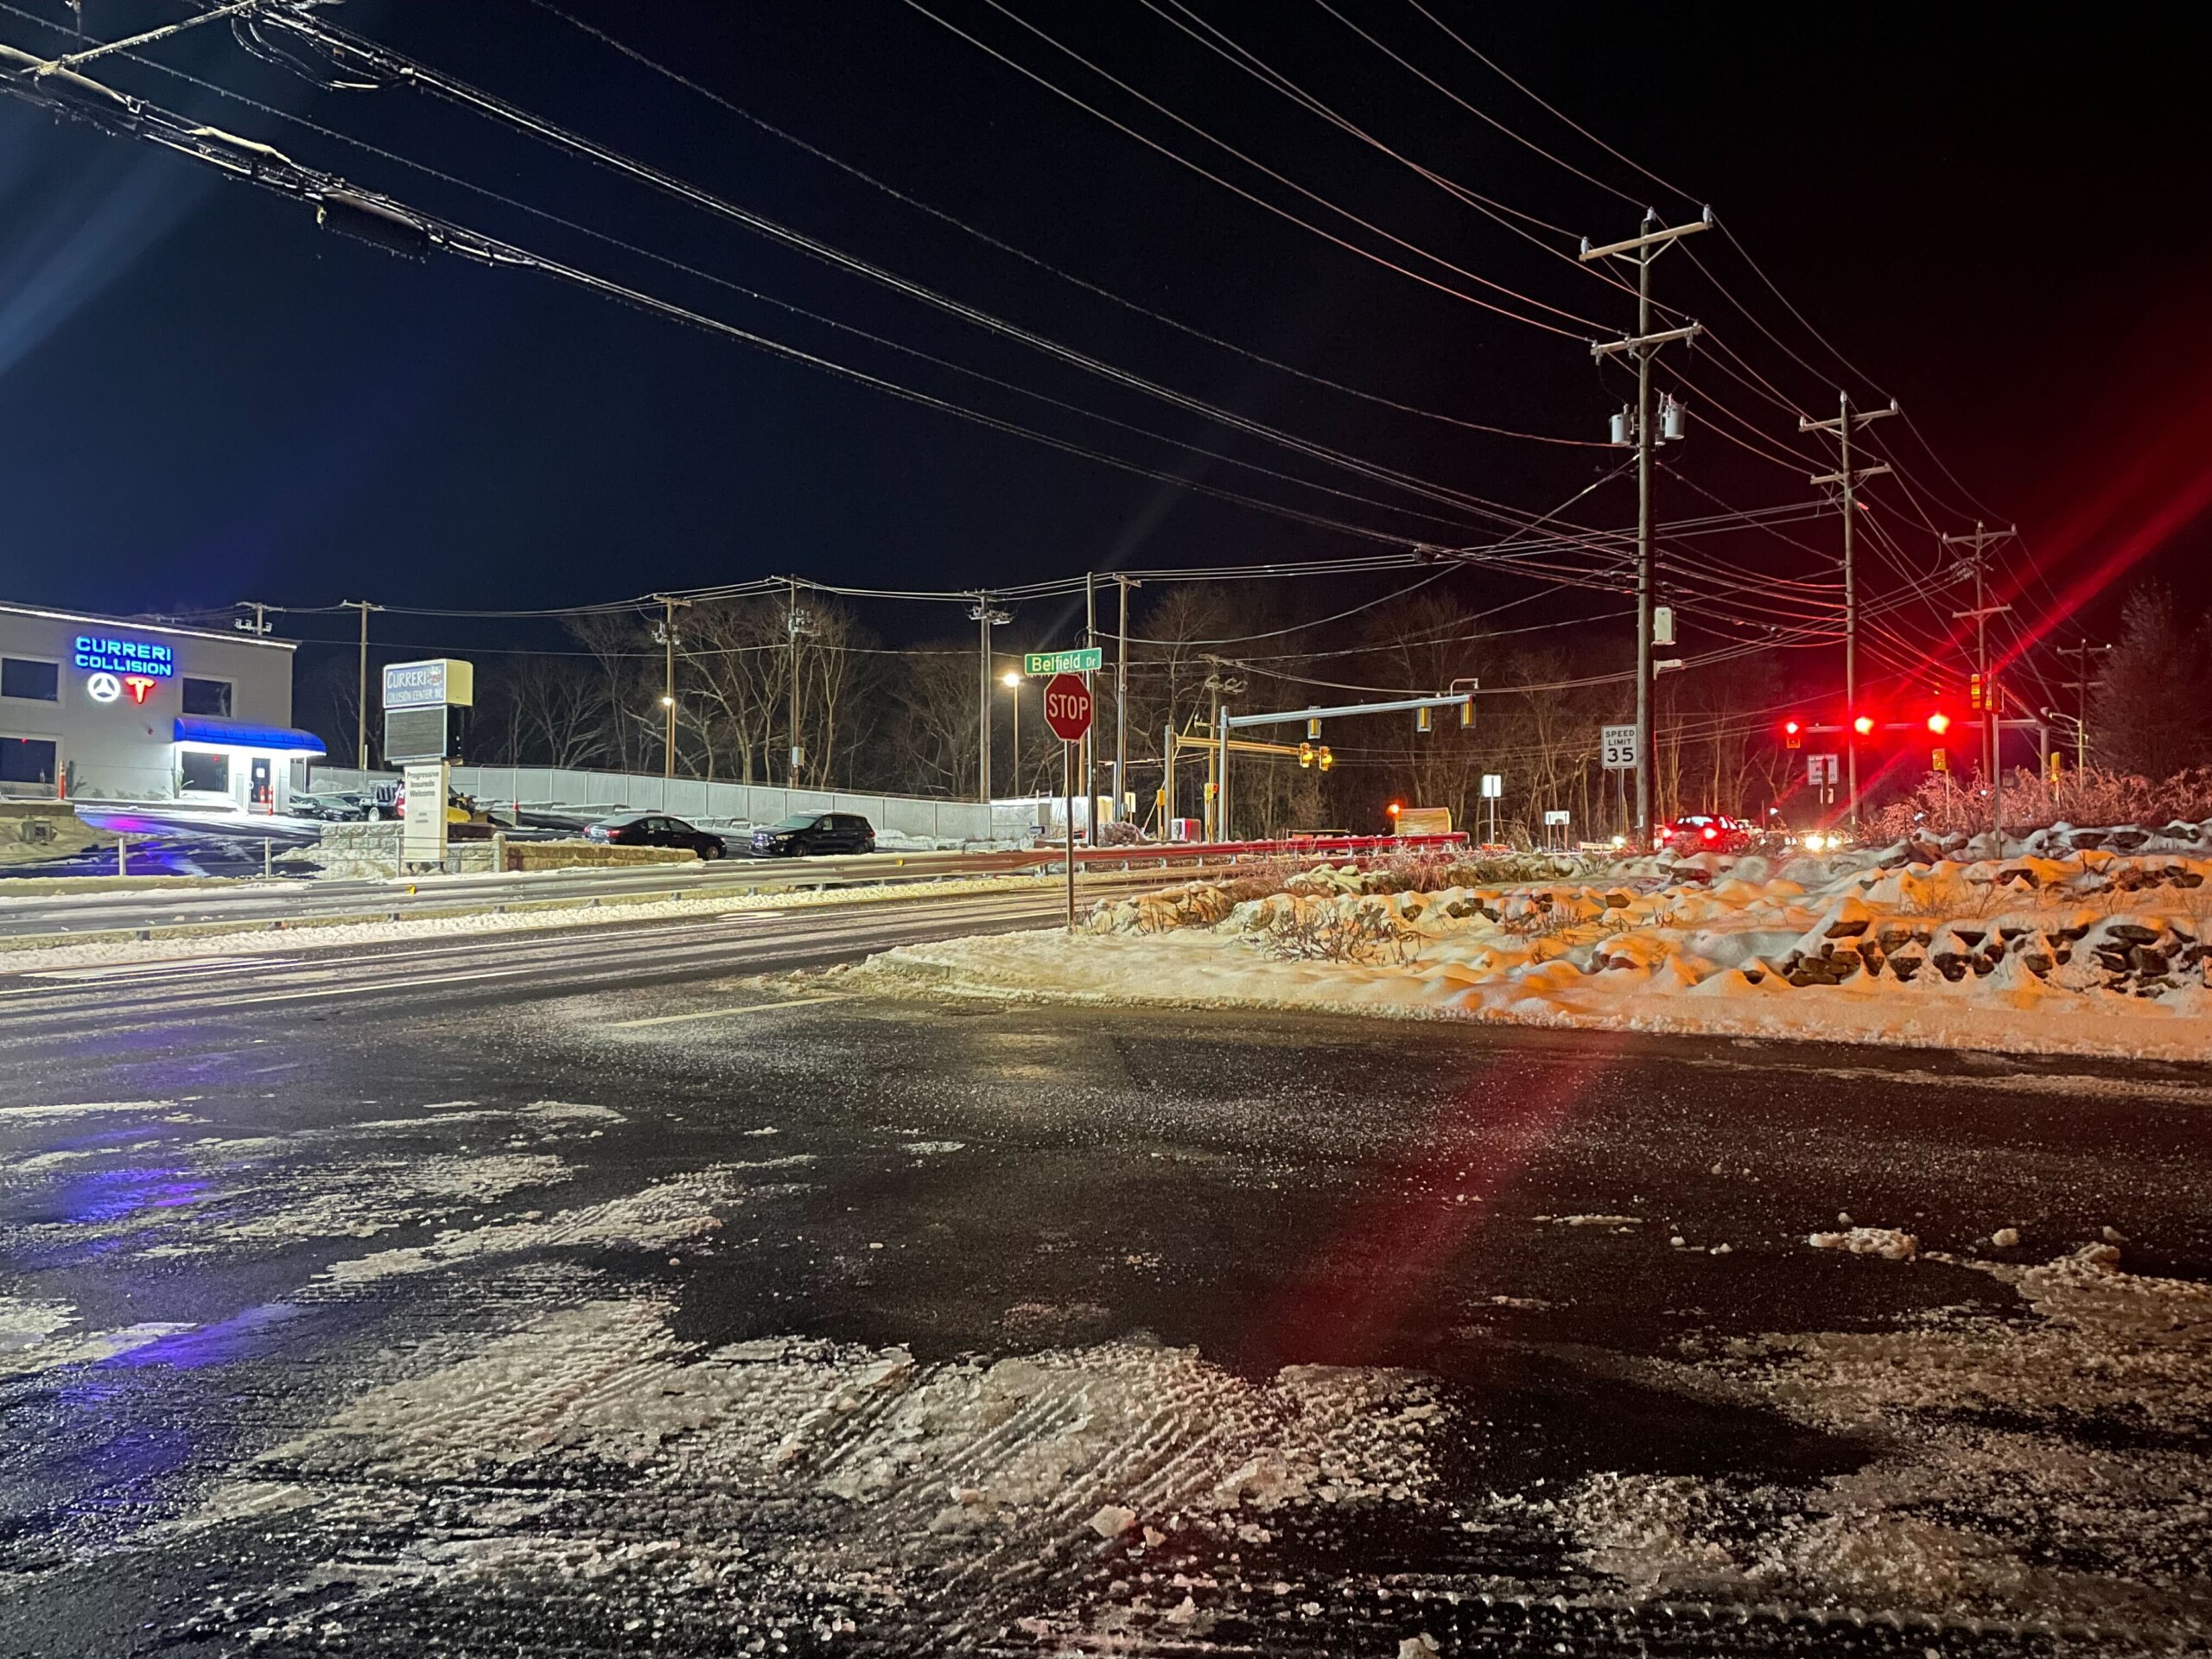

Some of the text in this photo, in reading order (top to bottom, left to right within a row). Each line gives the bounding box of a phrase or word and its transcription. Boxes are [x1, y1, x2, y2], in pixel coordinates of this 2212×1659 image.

[75, 636, 172, 661] CURRERI
[75, 653, 172, 676] COLLISION
[1032, 655, 1096, 672] Belfield Dr
[387, 671, 427, 689] CURRERI
[413, 689, 433, 701] CENTER
[1048, 693, 1089, 721] STOP
[1605, 729, 1635, 738] SPEED
[1607, 747, 1634, 762] 35
[407, 772, 439, 780] Progressive
